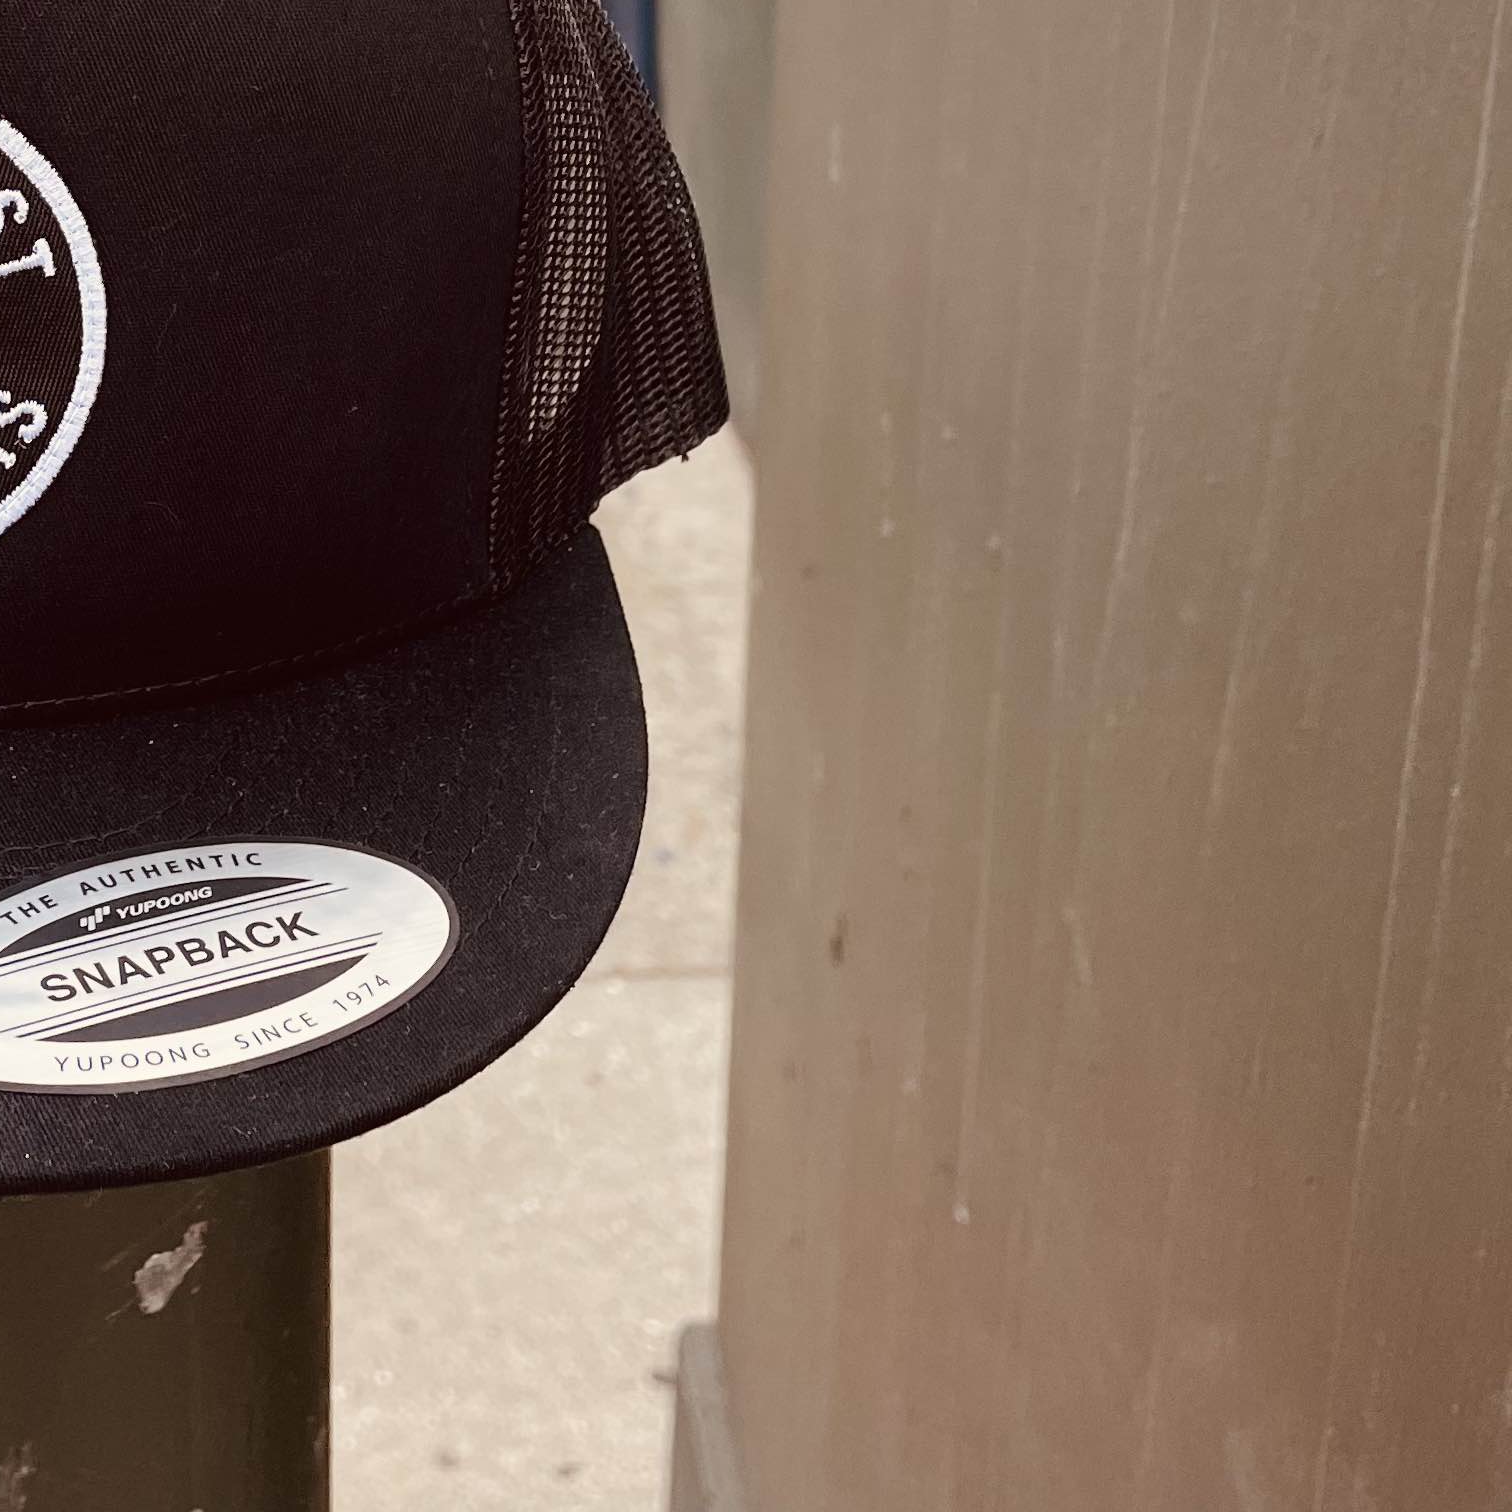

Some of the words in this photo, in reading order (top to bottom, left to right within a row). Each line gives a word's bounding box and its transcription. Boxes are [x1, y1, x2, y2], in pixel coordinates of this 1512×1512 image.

[0, 894, 58, 927] THE
[79, 852, 264, 896] AUTHENTIC
[115, 886, 213, 920] YUPOONG
[39, 911, 319, 1003] SNAPBACK
[54, 1042, 211, 1073] YUPOONG
[234, 1011, 319, 1052] SINCE
[332, 974, 391, 1014] 1974
